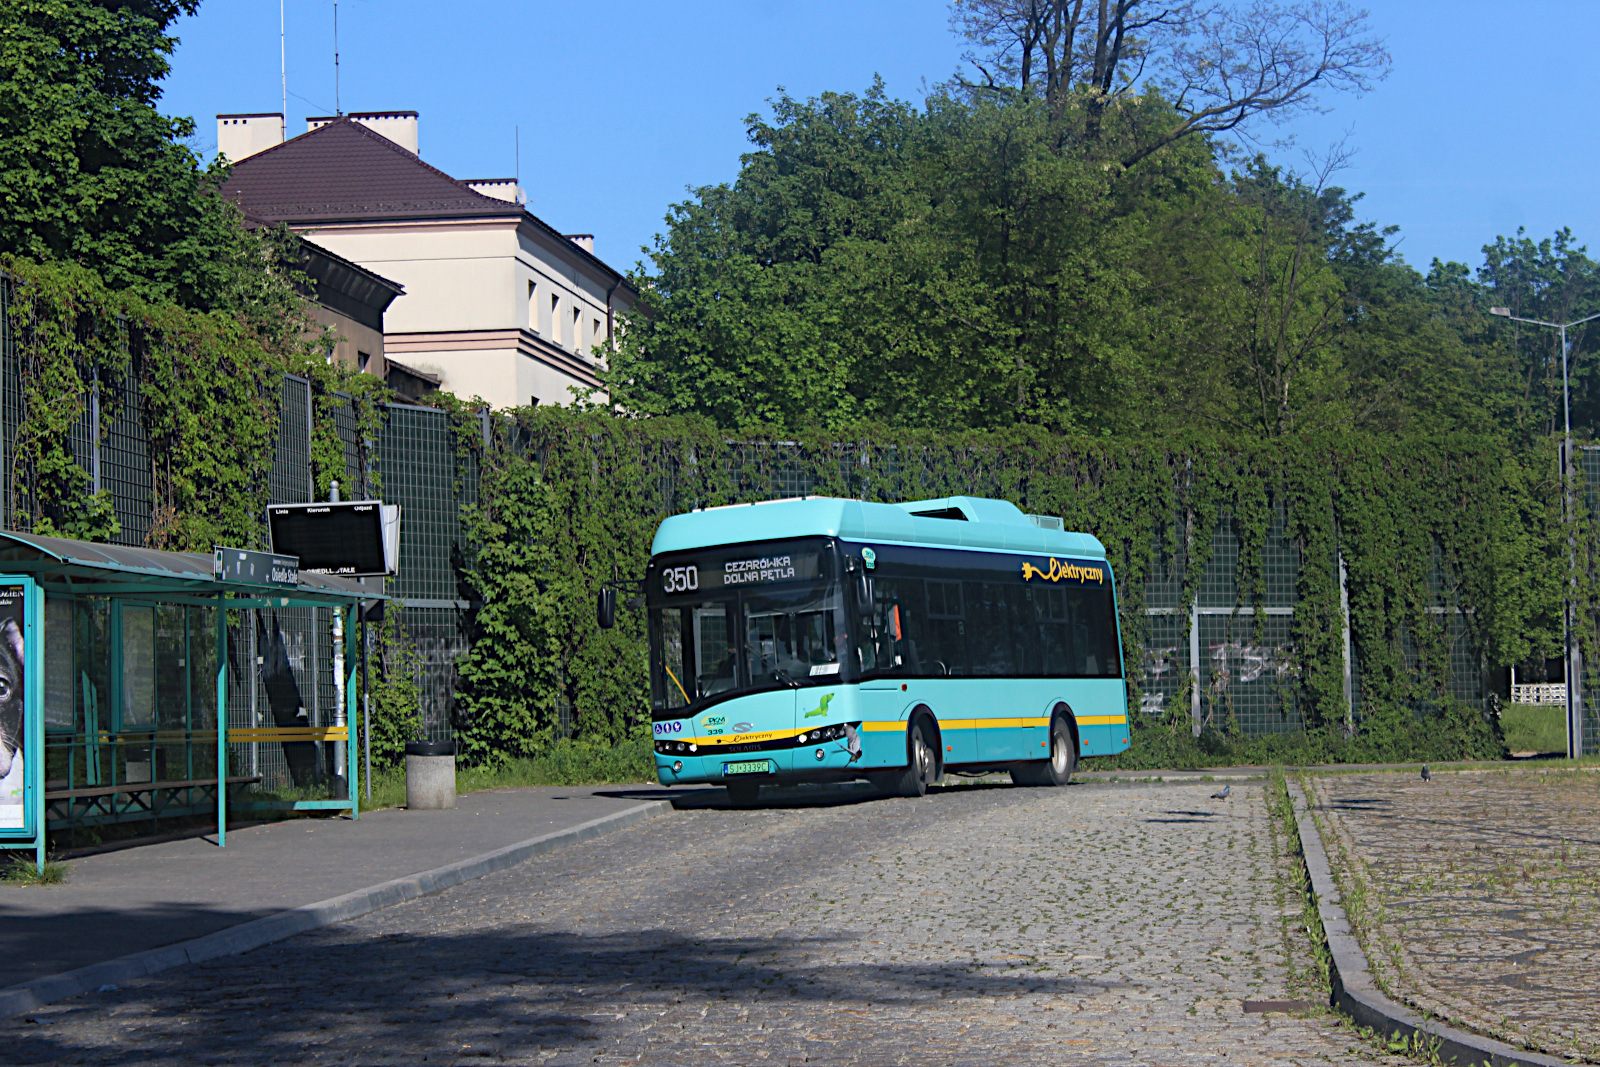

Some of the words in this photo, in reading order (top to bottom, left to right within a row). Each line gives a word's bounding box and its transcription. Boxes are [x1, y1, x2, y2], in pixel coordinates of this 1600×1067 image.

[725, 556, 791, 573] CEZARÓWKA
[272, 567, 287, 583] Osiedle
[663, 565, 699, 593] 350
[723, 571, 759, 585] DOLNA
[760, 567, 795, 581] PĘTLA
[728, 744, 762, 752] SOLARIS
[742, 762, 767, 773] 3339C
